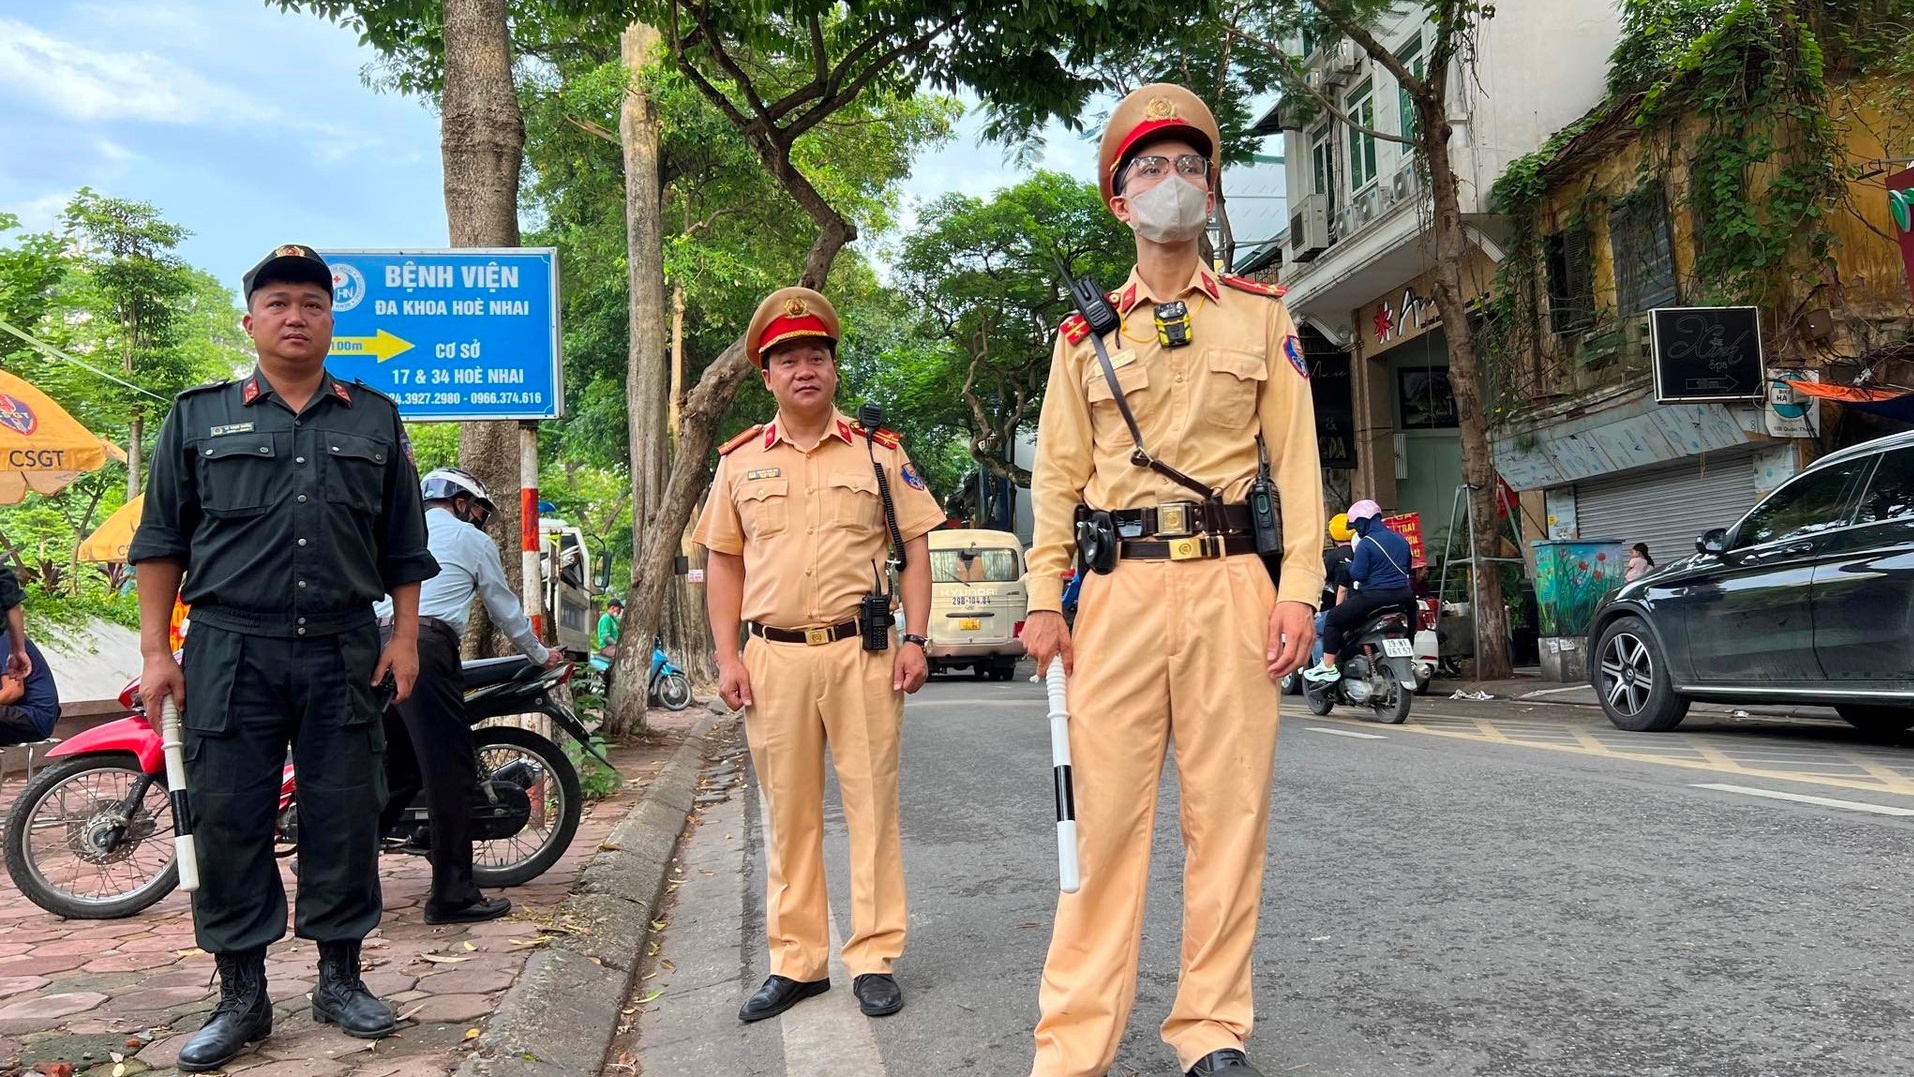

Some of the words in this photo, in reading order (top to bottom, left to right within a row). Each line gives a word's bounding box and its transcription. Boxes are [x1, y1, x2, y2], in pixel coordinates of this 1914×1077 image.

[385, 261, 454, 293] BỆNH
[461, 261, 519, 293] VIỆN
[375, 300, 398, 316] ĐA
[403, 300, 447, 315] KHOA
[453, 297, 484, 315] HOÈ
[489, 300, 529, 316] NHAI
[435, 342, 456, 359] CƠ
[460, 338, 481, 359] SỞ
[392, 369, 411, 384] 17
[415, 369, 426, 384] &
[431, 369, 450, 384] 34
[454, 366, 483, 384] HOÈ
[488, 368, 524, 384] NHAI
[384, 392, 461, 405] 24.3927.2980
[470, 391, 542, 404] 0966.374.616
[9, 450, 64, 467] CSGT
[940, 588, 998, 596] HYUNDAI
